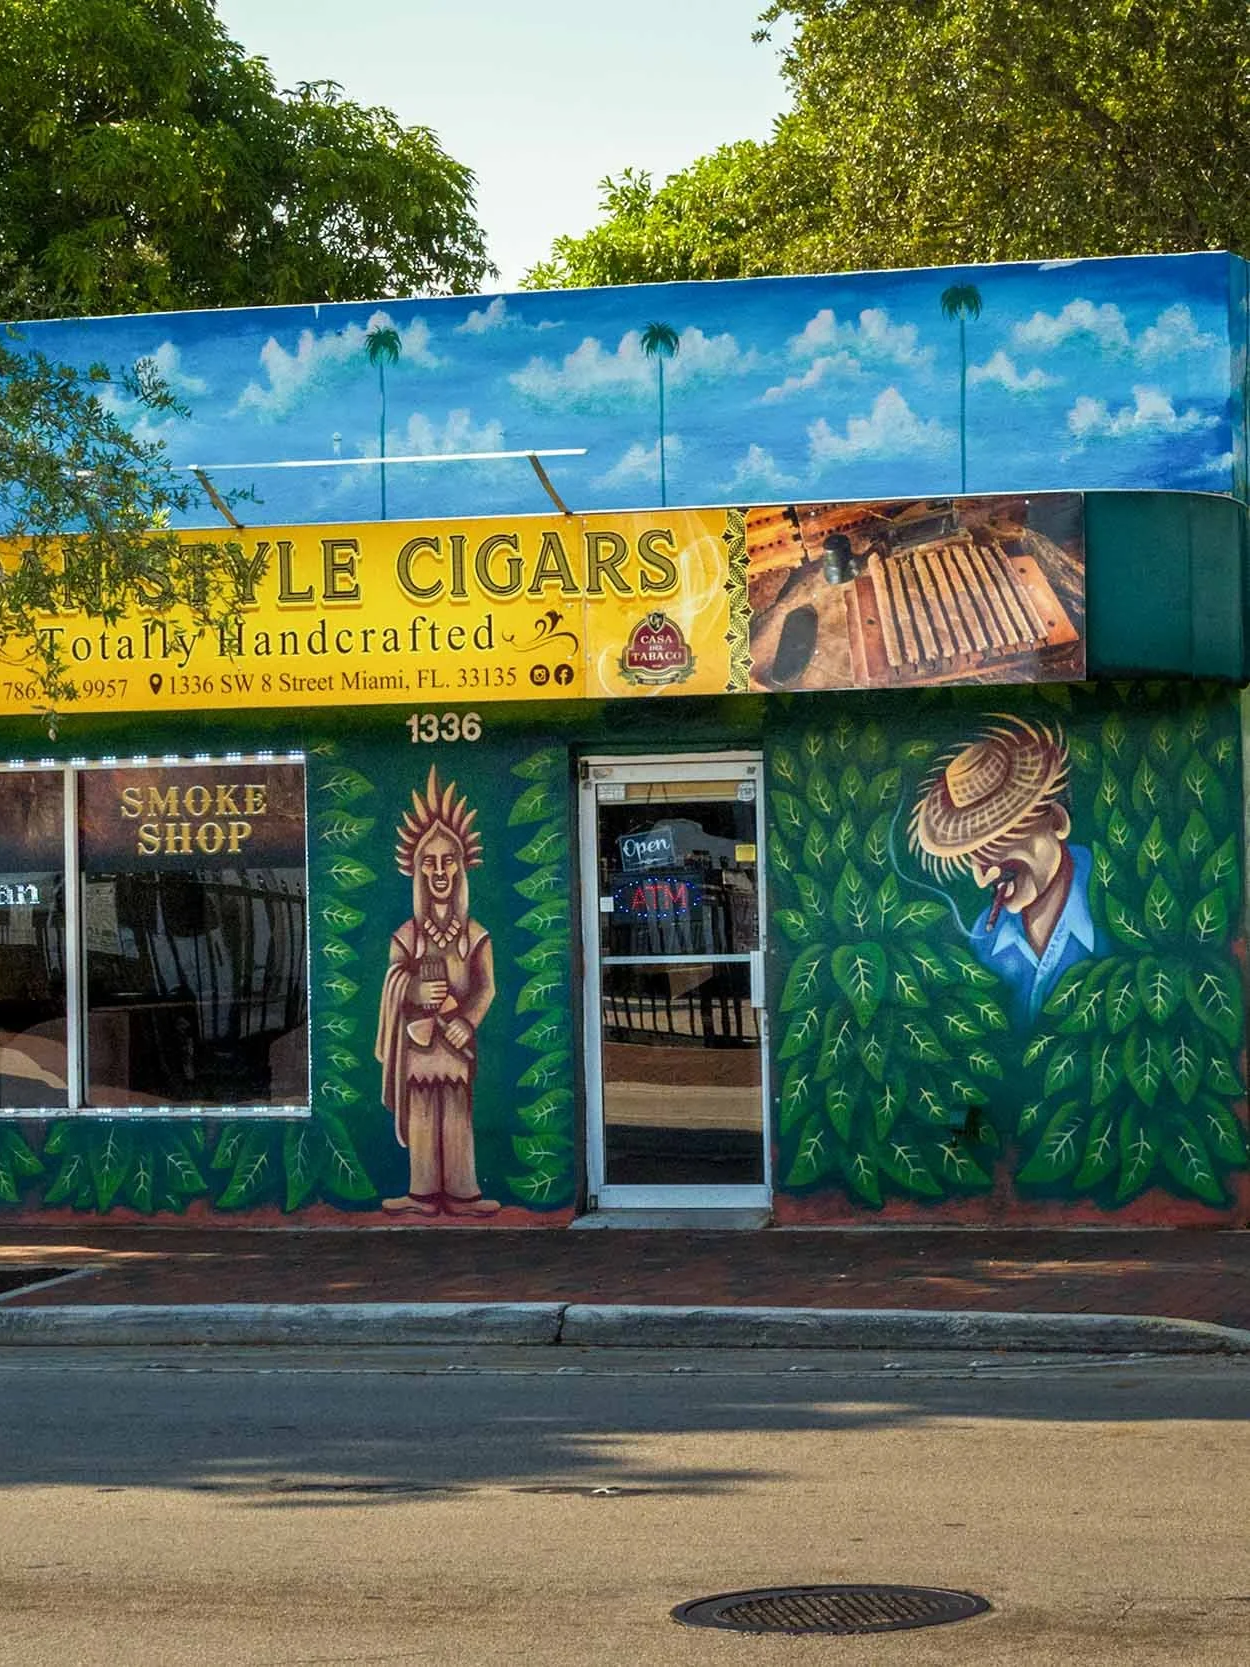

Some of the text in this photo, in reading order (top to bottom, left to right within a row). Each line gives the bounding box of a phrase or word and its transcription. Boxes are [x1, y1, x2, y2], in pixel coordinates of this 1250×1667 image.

[132, 539, 360, 606] STYLE
[397, 528, 680, 600] CIGARS
[39, 614, 495, 668] Totally Handcrafted
[640, 635, 673, 645] CASA
[631, 651, 682, 661] TABACO
[3, 667, 517, 700] 786.8.9957 1336 SW 8 Street Miami, FL. 33135
[406, 712, 482, 743] 1336
[121, 785, 268, 817] SMOKE
[138, 821, 252, 855] SHOP
[623, 838, 671, 861] Open
[632, 883, 687, 910] ATM
